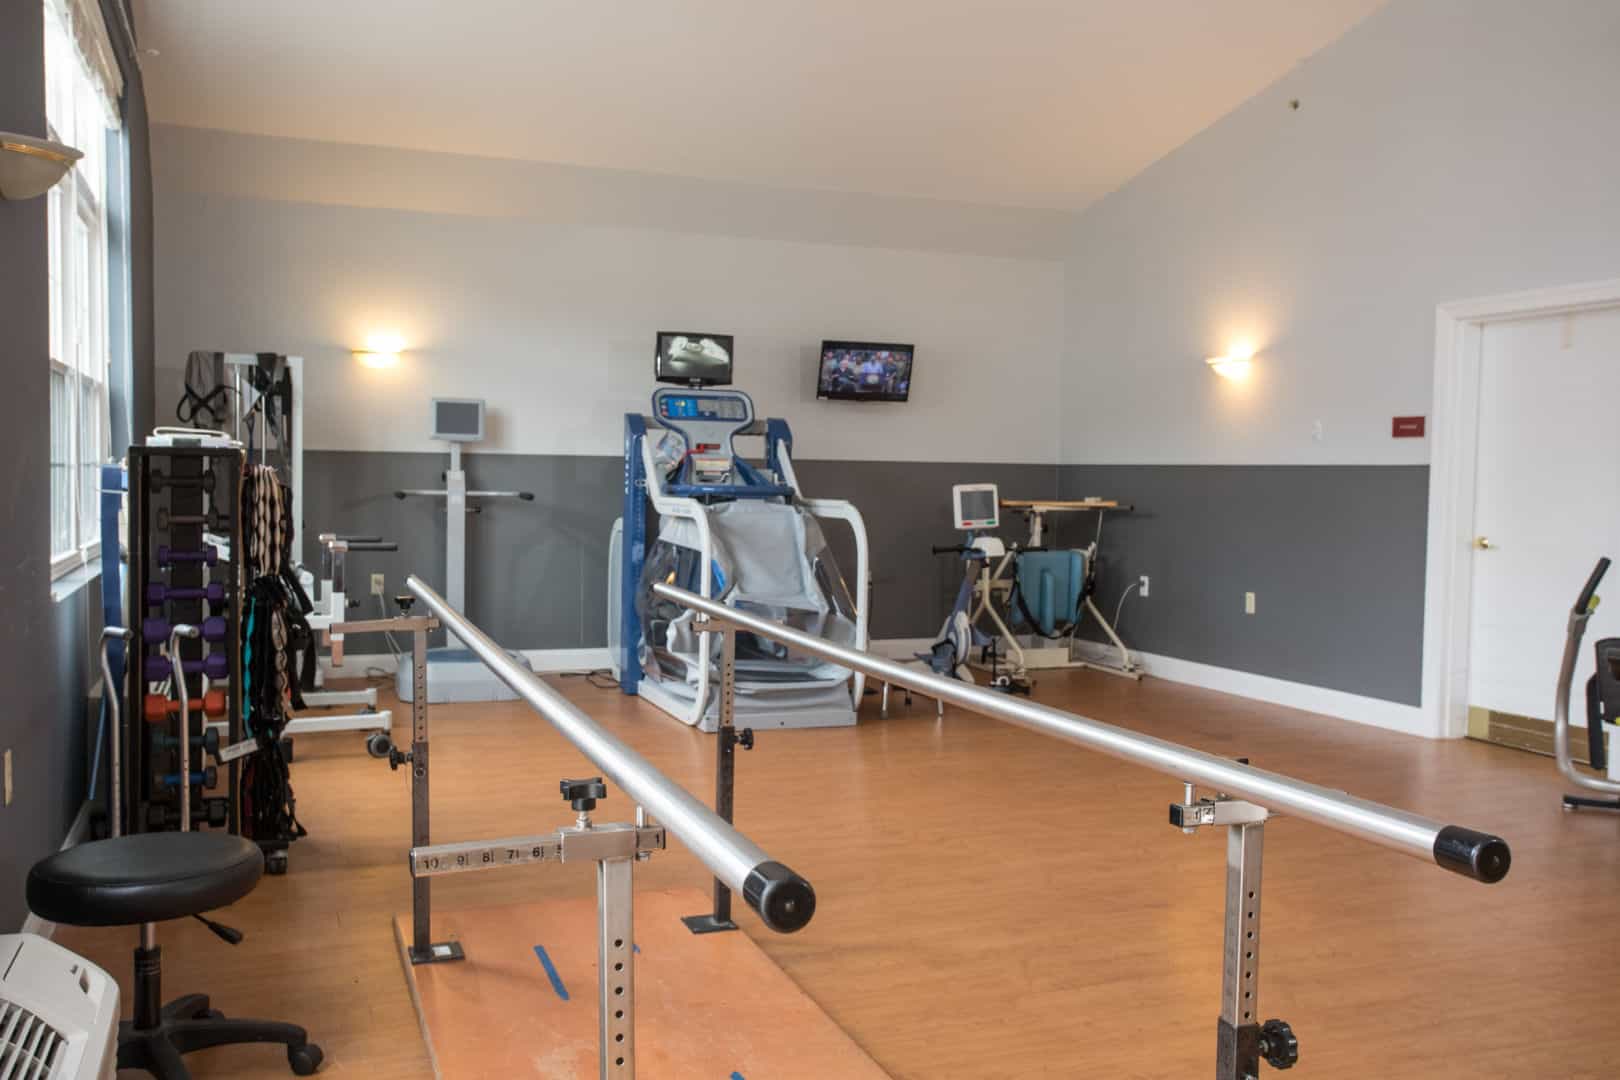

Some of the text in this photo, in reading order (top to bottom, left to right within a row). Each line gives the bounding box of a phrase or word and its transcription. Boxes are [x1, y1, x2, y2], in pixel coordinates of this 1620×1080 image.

[424, 847, 540, 869] 10 9 8 7 6
